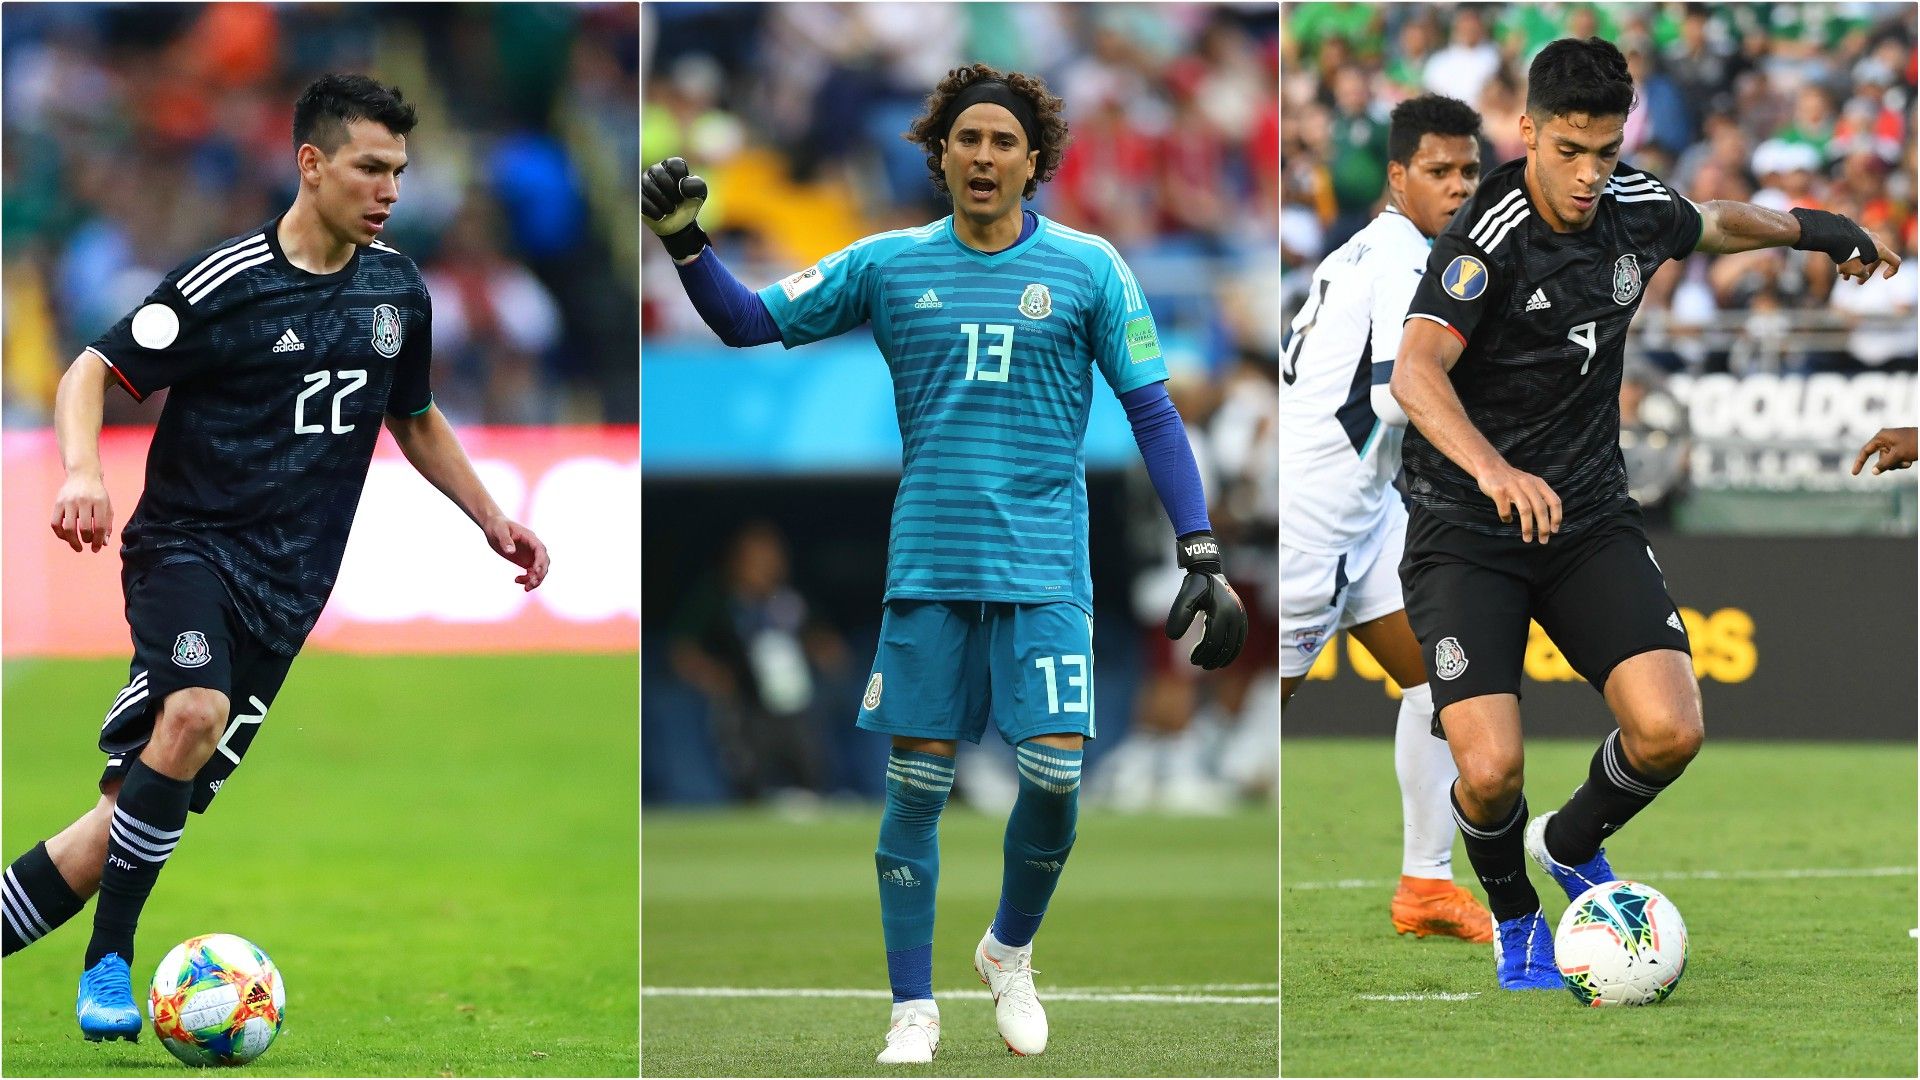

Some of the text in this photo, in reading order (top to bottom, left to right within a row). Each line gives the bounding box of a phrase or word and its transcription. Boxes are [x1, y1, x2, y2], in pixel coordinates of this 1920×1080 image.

[914, 300, 943, 309] adidas
[1525, 294, 1551, 312] adidas
[272, 342, 305, 353] adidas
[960, 323, 1015, 382] 13
[1567, 321, 1597, 376] 9
[294, 369, 368, 435] 22
[1035, 654, 1089, 714] 13
